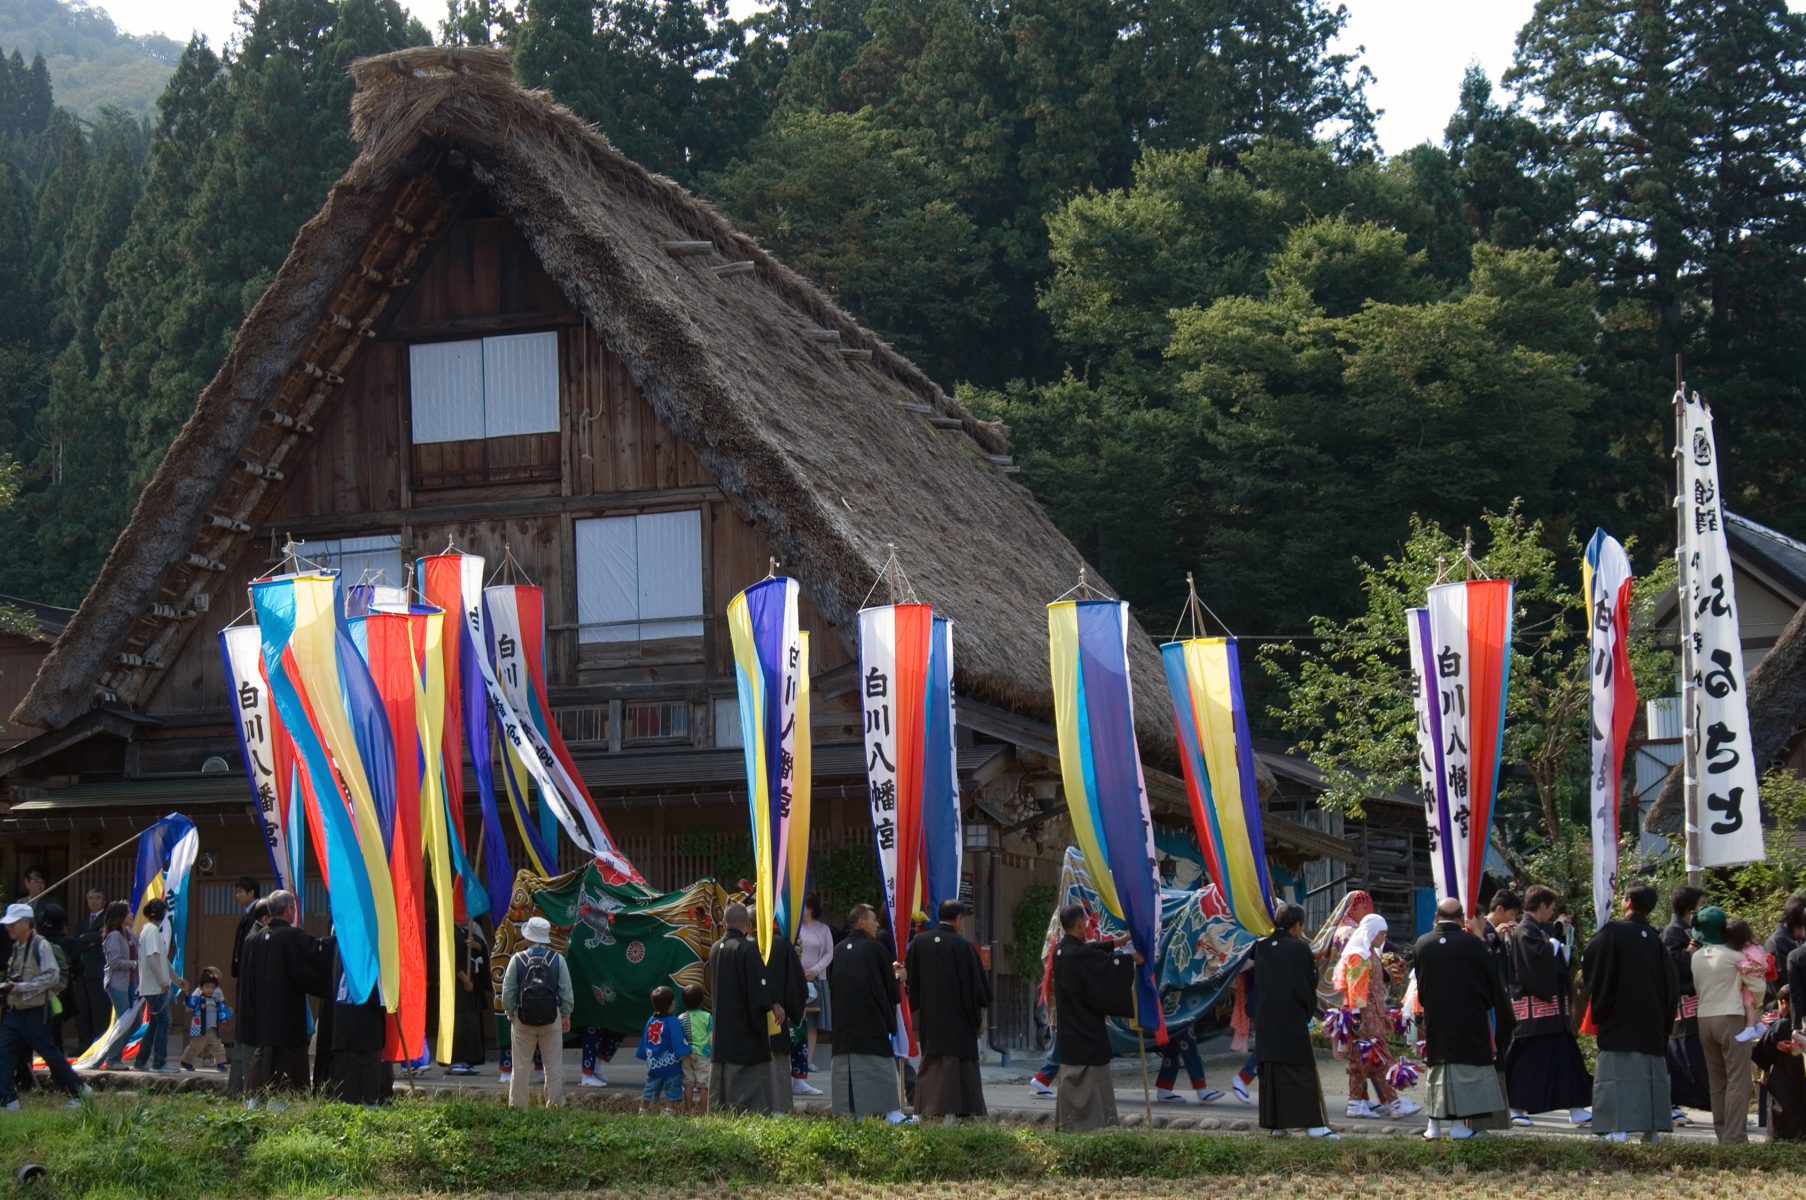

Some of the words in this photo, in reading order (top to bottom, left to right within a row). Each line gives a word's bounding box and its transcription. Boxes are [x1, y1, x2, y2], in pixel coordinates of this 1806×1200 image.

[866, 667, 895, 851] 白川八幡宮
[1437, 645, 1470, 839] 白川八幡宮
